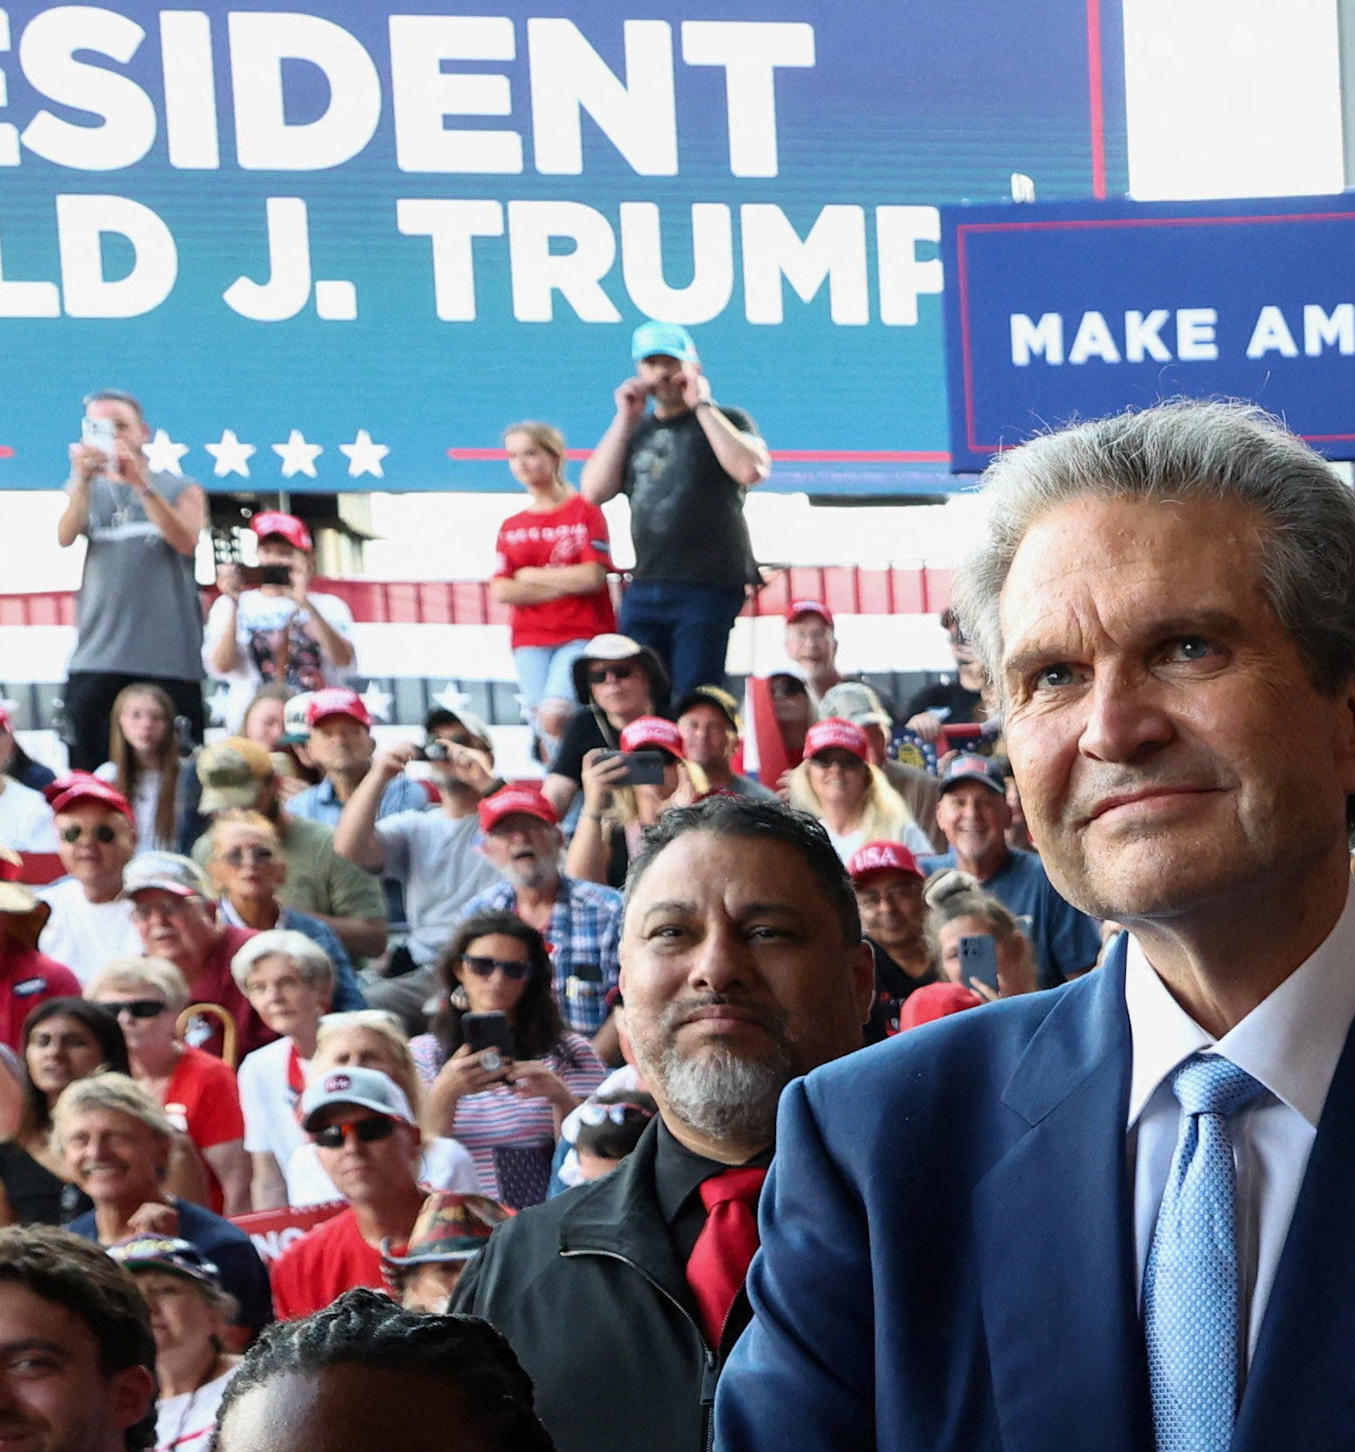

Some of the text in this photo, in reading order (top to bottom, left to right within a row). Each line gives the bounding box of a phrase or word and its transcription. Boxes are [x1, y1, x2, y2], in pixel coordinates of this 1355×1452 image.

[222, 197, 357, 321] J.
[1010, 308, 1219, 366] MAKE
[855, 846, 896, 870] USA
